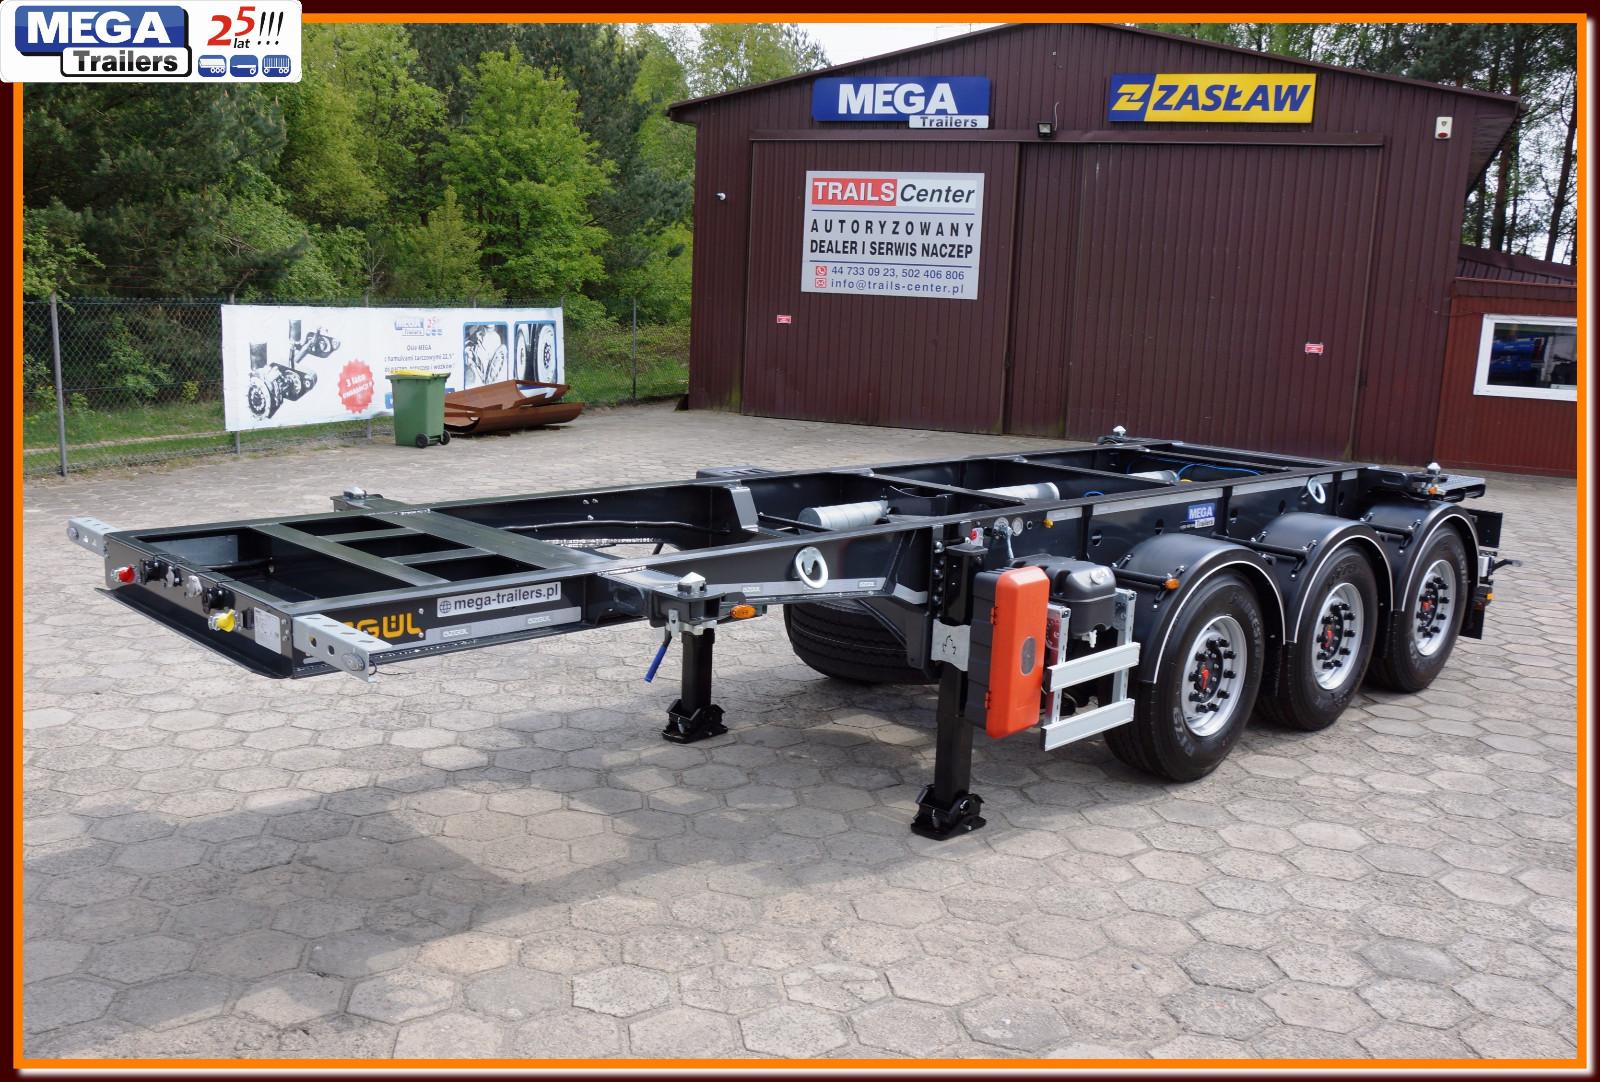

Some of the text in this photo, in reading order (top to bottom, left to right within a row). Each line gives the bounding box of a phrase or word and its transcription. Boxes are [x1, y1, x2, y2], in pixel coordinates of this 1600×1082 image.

[838, 83, 958, 114] MEGA
[1152, 84, 1311, 112] ZASŁAW
[920, 116, 978, 127] Trailers
[814, 181, 975, 203] TRAILS Center
[811, 218, 974, 237] AUTORYZOWANY
[810, 239, 973, 259] DEALER I SERWIS NACZEP
[831, 266, 844, 275] 44
[847, 266, 865, 276] 733
[868, 267, 880, 277] 09
[901, 269, 921, 278] 502
[923, 269, 942, 279] 406
[945, 270, 965, 280] 806
[831, 278, 965, 296] info@trails-center.pl
[1188, 506, 1214, 520] MEGA
[453, 584, 559, 610] mega-trailers.pl
